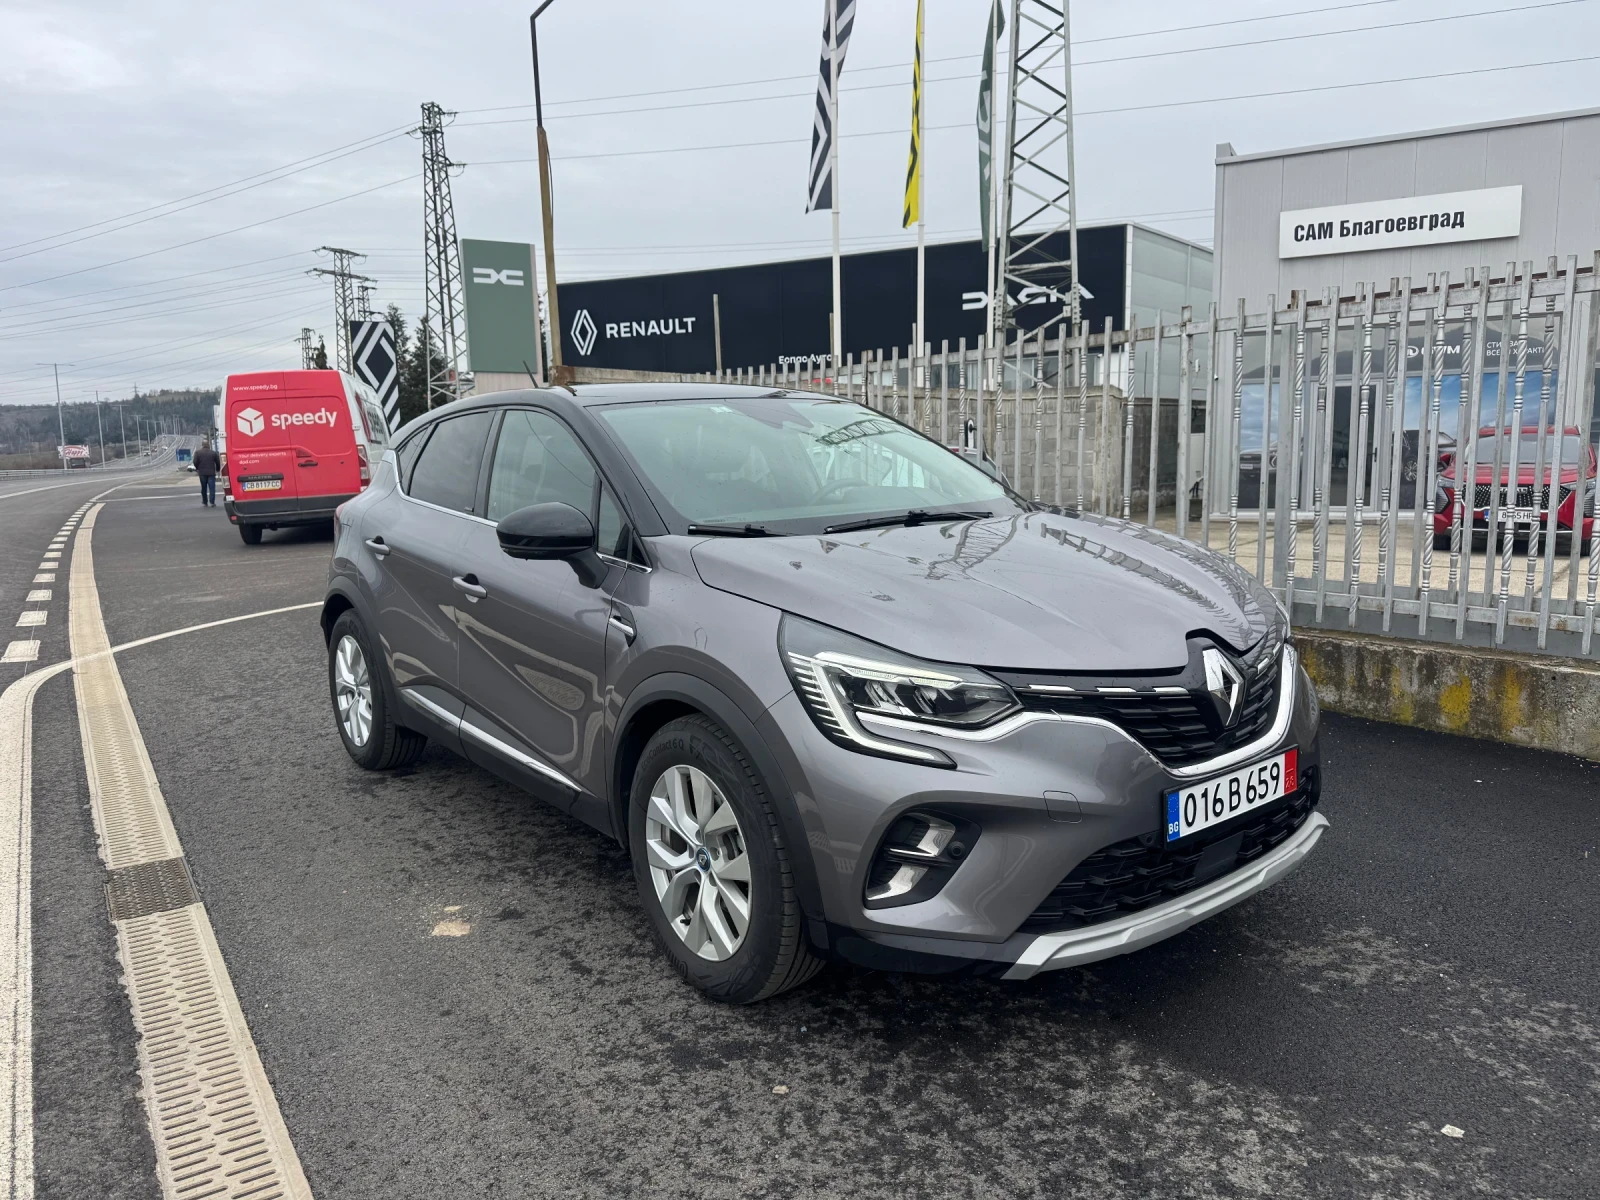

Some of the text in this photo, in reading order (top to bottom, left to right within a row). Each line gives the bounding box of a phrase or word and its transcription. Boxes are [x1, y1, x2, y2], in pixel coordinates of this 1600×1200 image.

[1294, 210, 1466, 243] САМ Благоевград
[605, 317, 696, 339] RENAULT
[271, 407, 337, 430] speedy
[1168, 821, 1179, 834] BG
